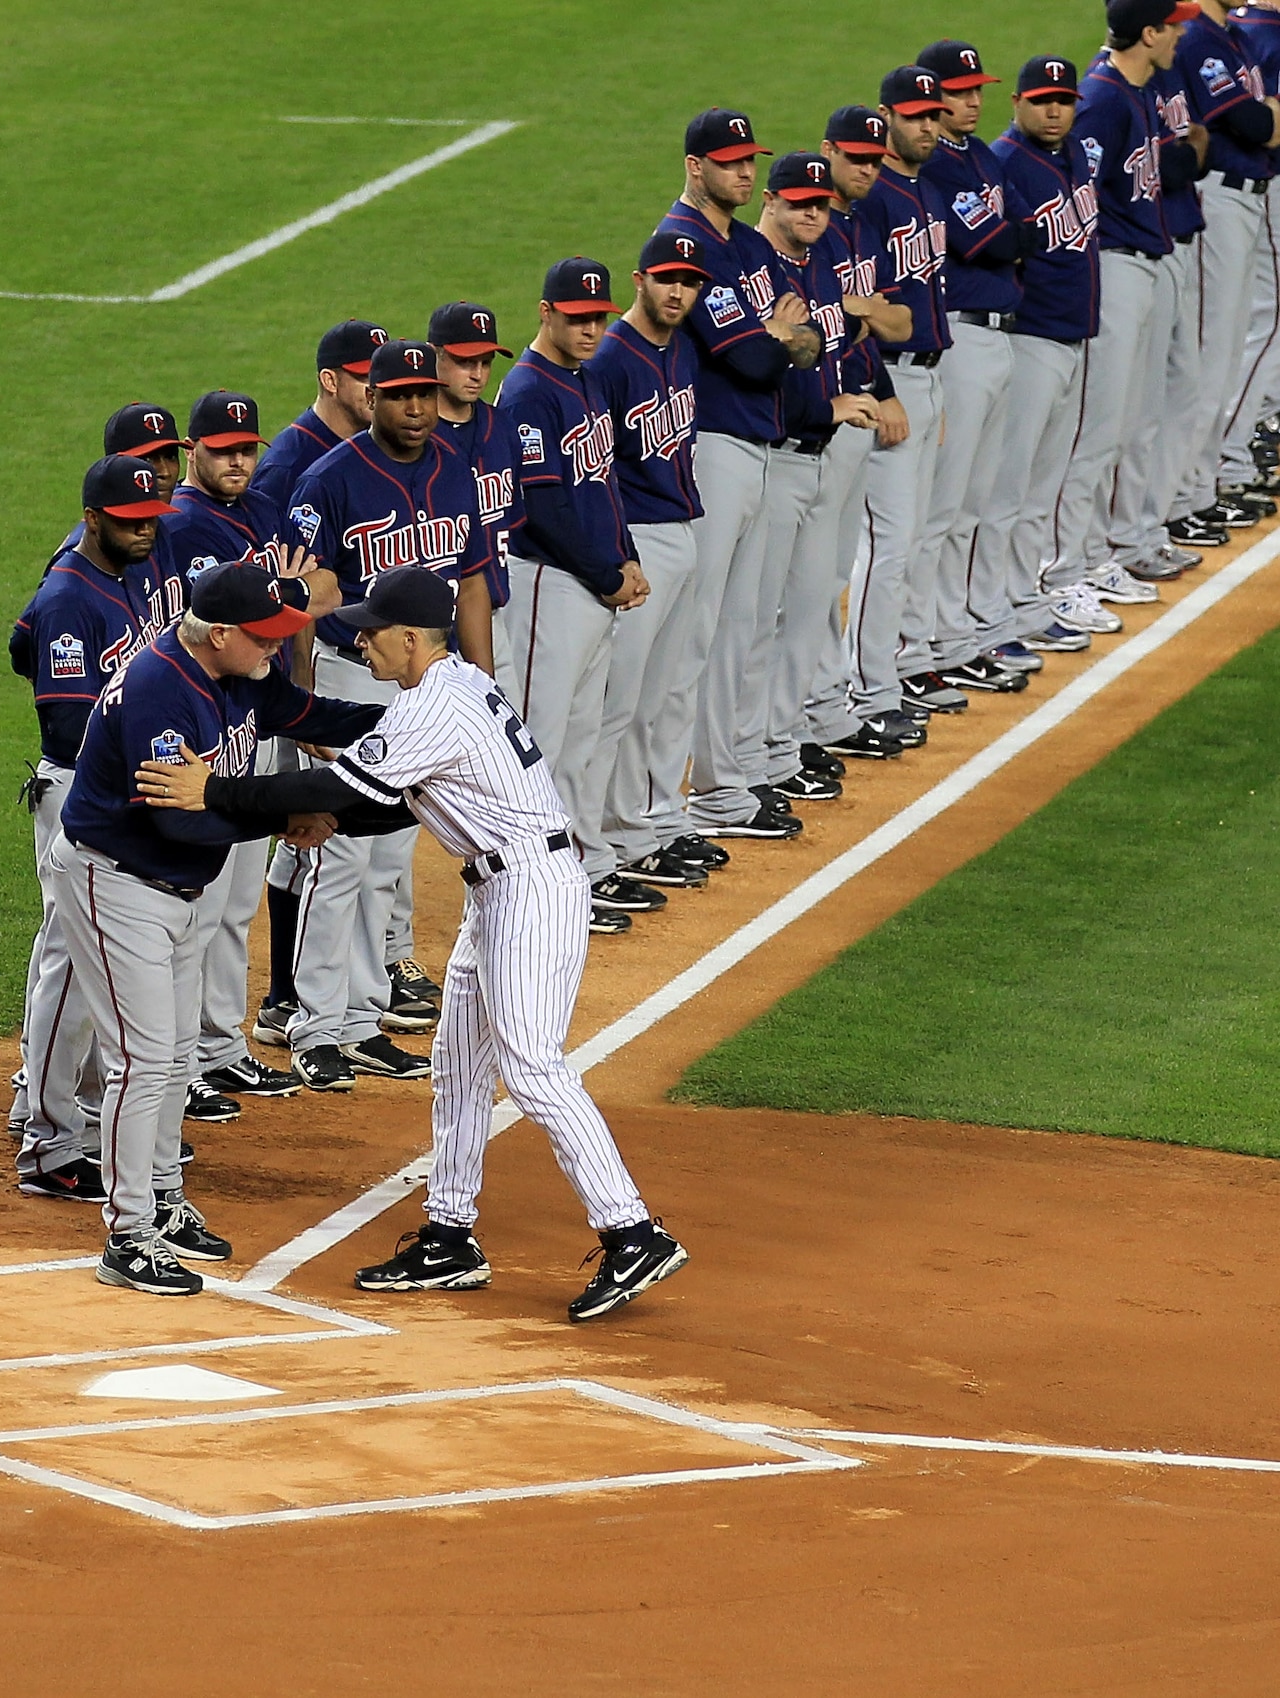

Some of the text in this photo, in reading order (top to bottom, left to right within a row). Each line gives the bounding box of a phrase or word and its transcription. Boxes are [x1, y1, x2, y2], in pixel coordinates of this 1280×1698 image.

[561, 409, 614, 486] Twin
[471, 466, 513, 514] ins
[343, 510, 471, 583] Twins
[497, 530, 509, 567] 5
[486, 685, 543, 769] 2
